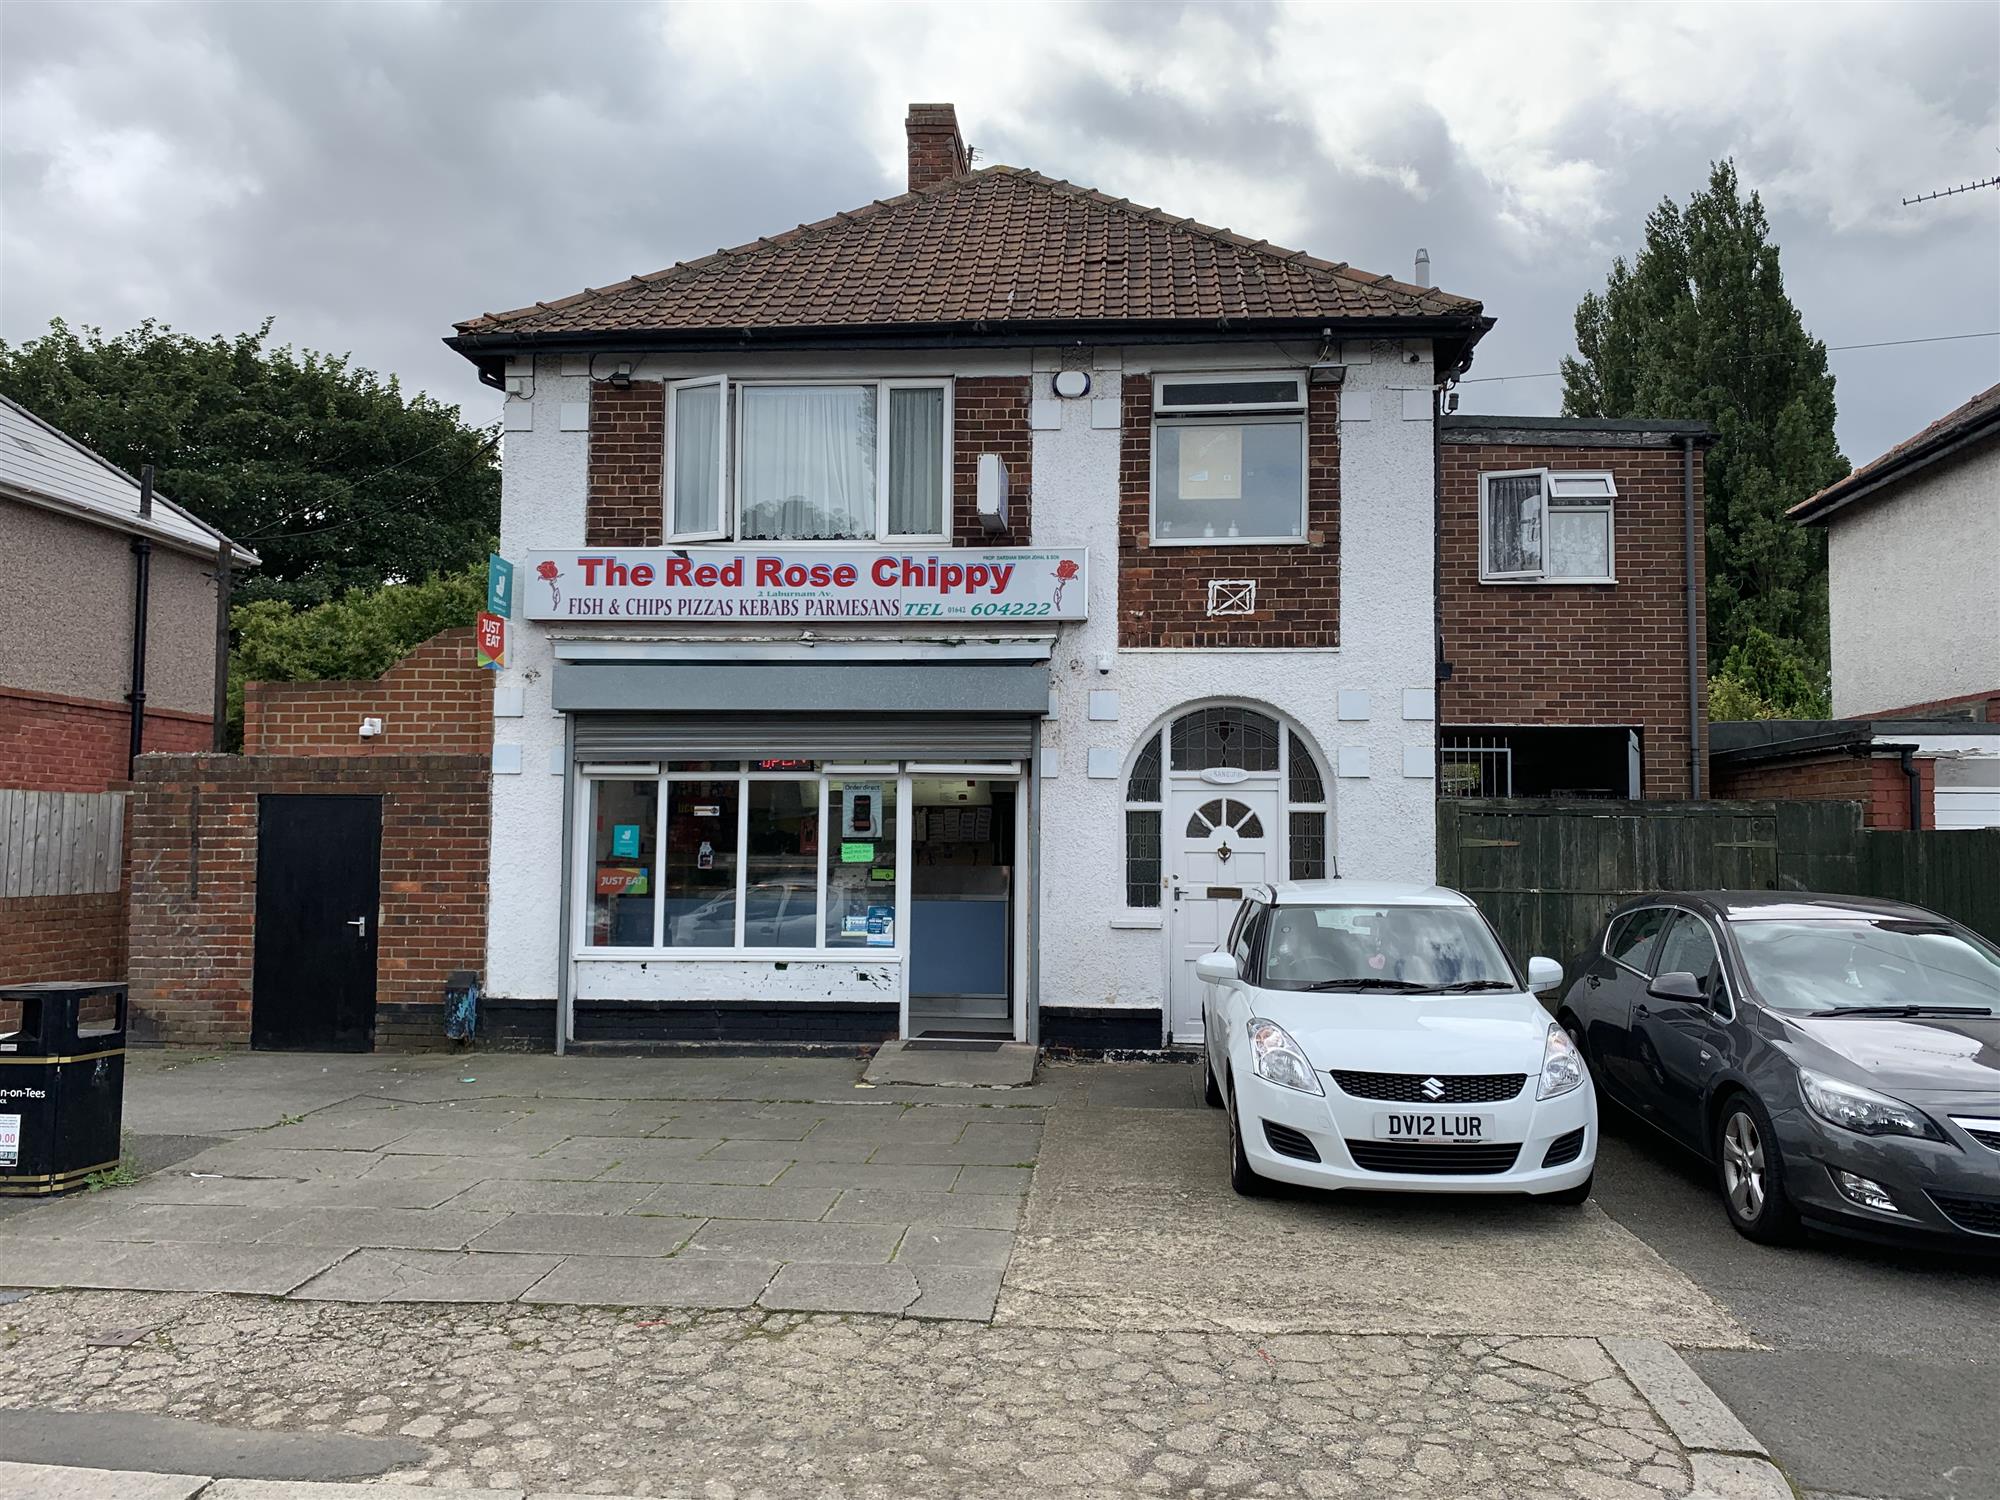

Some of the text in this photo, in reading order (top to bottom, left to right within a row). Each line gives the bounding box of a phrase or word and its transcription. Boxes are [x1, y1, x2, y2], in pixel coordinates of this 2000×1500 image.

[577, 556, 1016, 595] The Red Rose Chippy
[568, 598, 900, 616] FISH & CHIPS PIZZAS KEBABS PARMESANS
[903, 603, 1052, 616] TEL 01642 604222
[482, 619, 501, 634] JUST
[485, 635, 501, 648] EAT
[600, 876, 646, 886] JUST EAT
[1388, 1114, 1482, 1137] DV12 LUR
